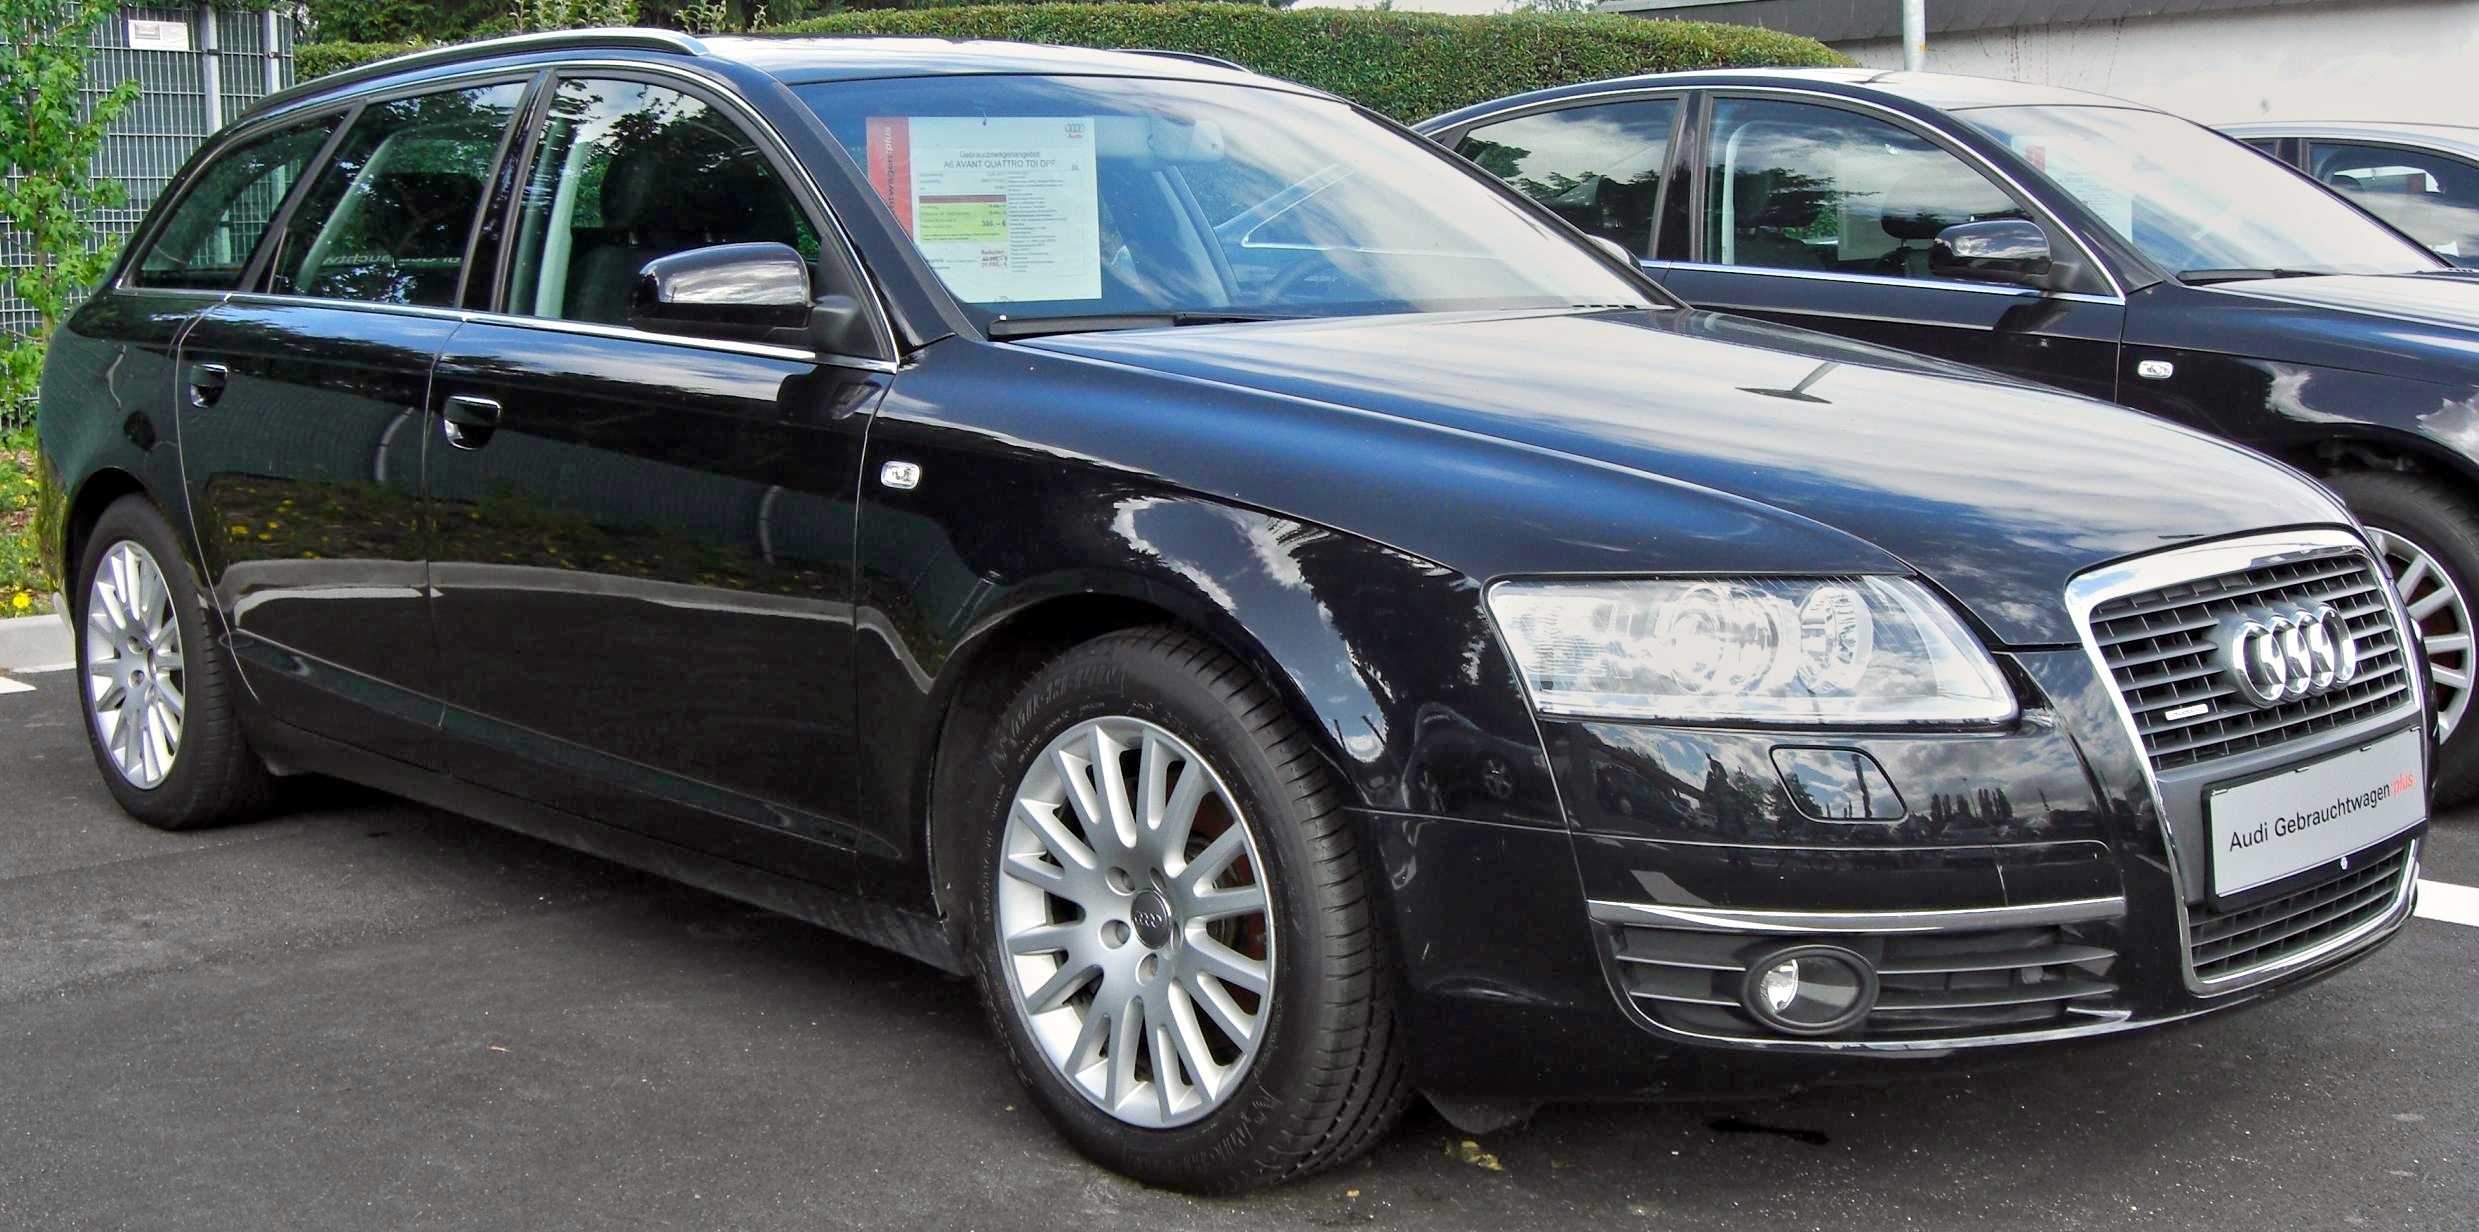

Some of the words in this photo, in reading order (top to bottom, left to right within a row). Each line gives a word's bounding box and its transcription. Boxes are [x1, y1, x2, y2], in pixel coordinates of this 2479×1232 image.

[956, 160, 982, 168] AVANT
[984, 159, 1023, 168] QUATTRO
[2229, 821, 2269, 851] Audi
[2274, 783, 2391, 837] Gebrauchtwagen
